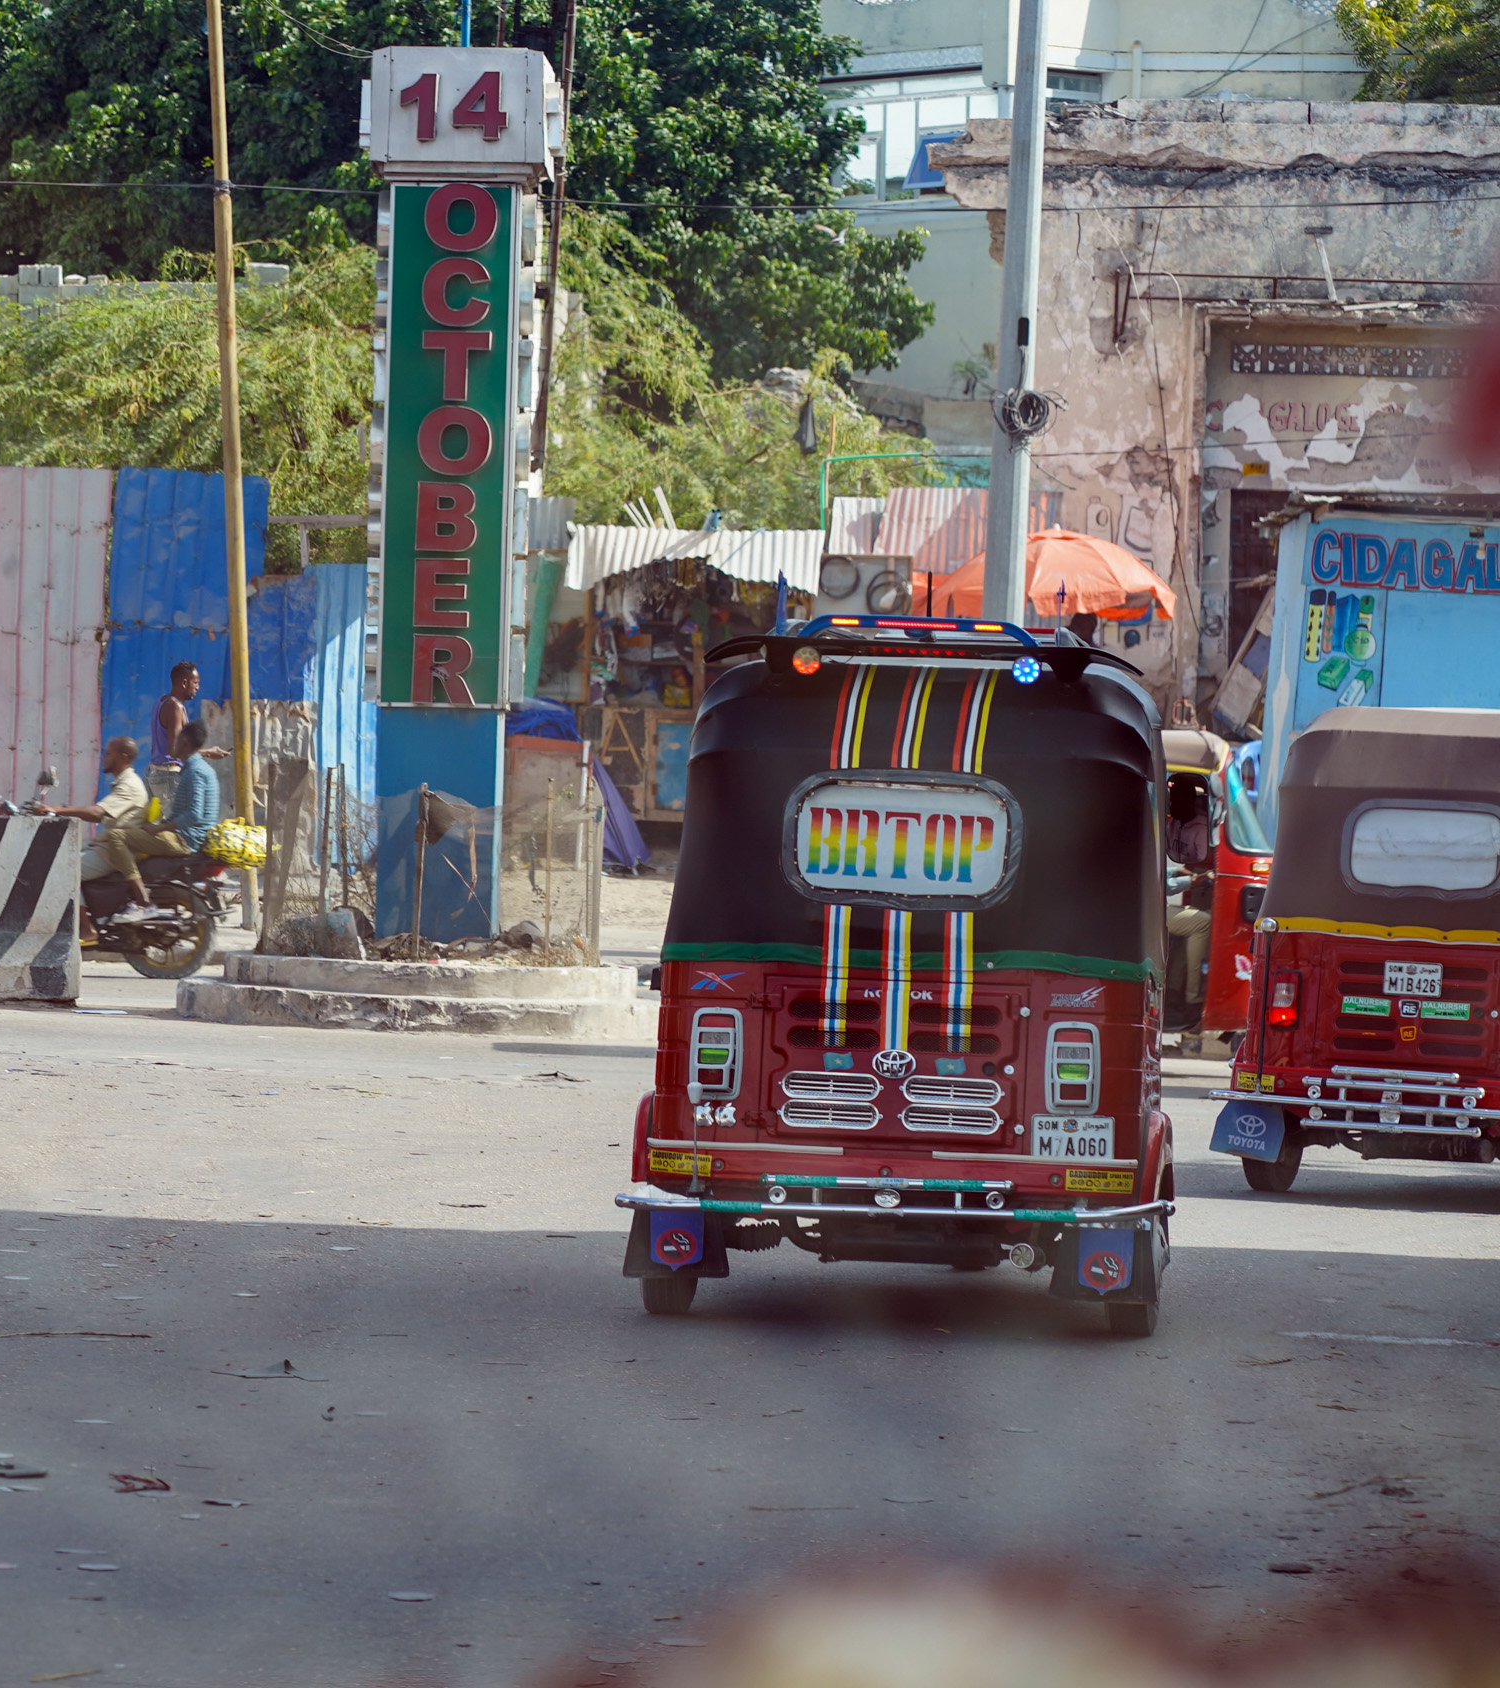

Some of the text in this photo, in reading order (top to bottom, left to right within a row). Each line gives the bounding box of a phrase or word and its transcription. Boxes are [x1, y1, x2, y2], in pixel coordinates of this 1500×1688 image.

[400, 70, 508, 142] 14
[410, 182, 498, 706] OCTOBER
[805, 806, 995, 885] BRTOP
[1387, 976, 1437, 994] M1B426
[1342, 997, 1390, 1007] DALNURSHE
[1402, 1005, 1416, 1014] RE
[1422, 1001, 1469, 1011] DALNURSHE
[1037, 1120, 1059, 1130] SOM
[1228, 1134, 1266, 1151] TOYOTA
